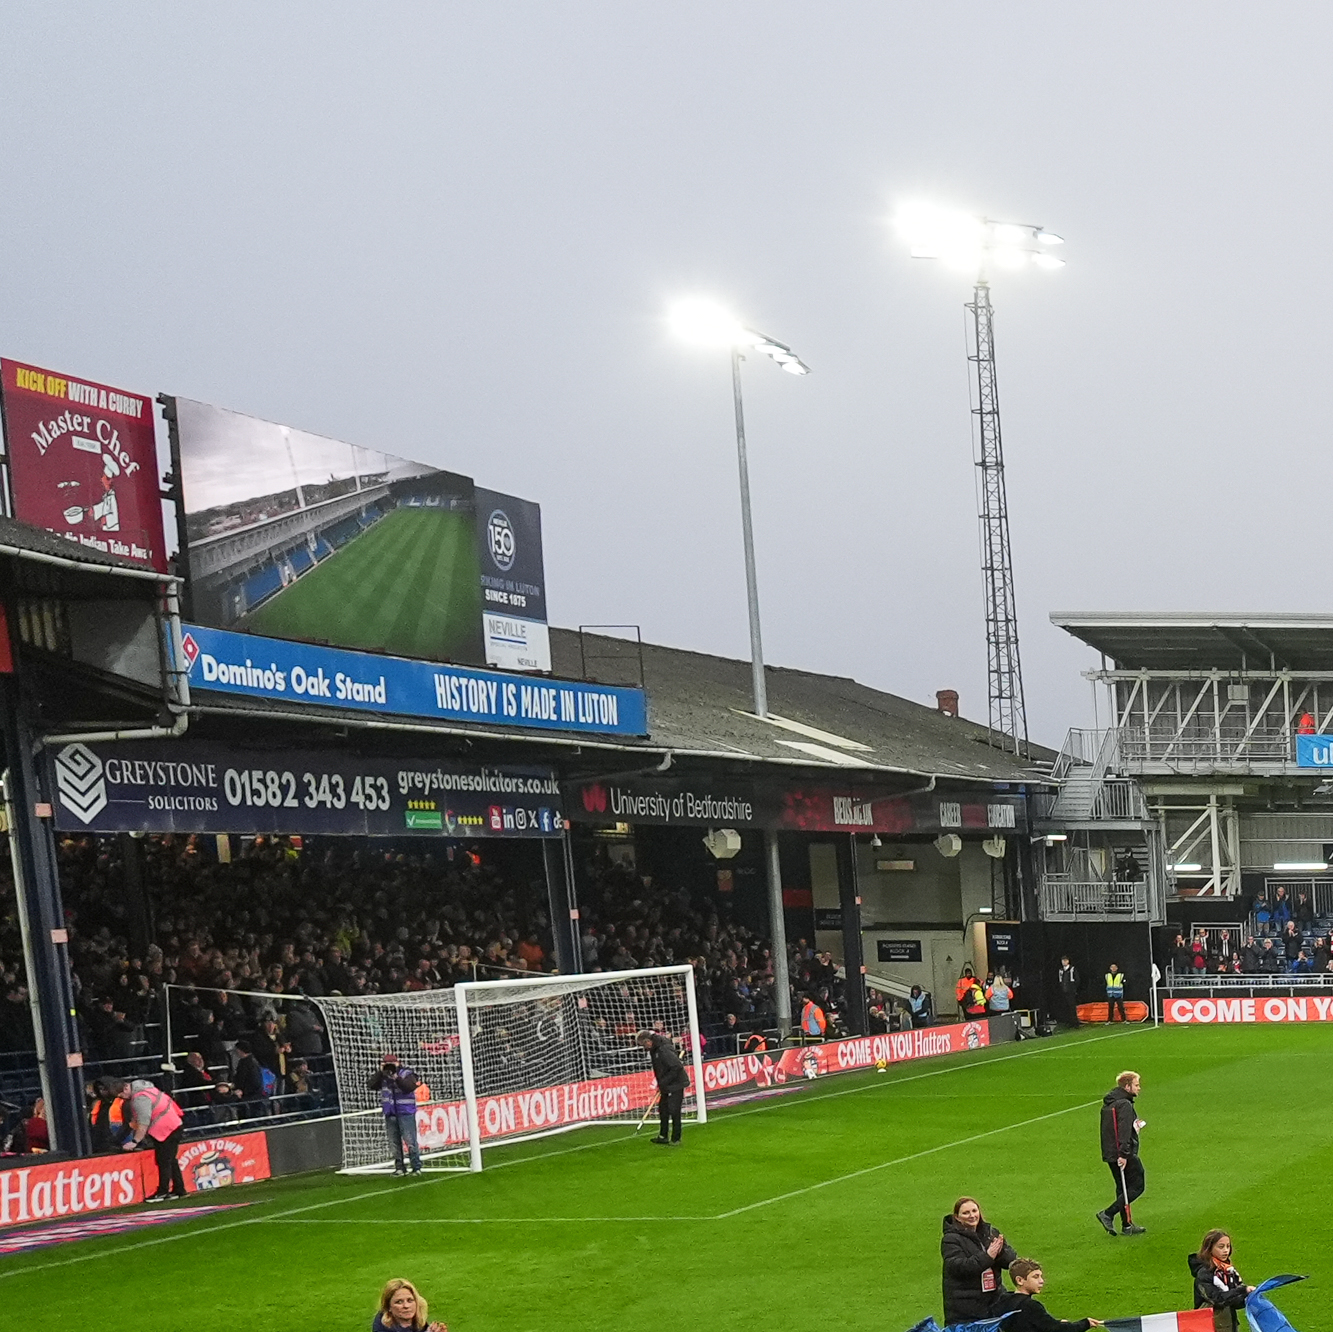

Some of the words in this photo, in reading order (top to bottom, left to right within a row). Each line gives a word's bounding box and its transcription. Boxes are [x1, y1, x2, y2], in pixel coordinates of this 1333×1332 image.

[16, 367, 45, 393] KICK
[46, 375, 67, 398] OFF
[68, 381, 98, 406] WITH
[99, 391, 107, 409] A
[108, 394, 143, 418] CURRY
[31, 409, 91, 456] Master
[96, 419, 141, 477] Chef
[80, 533, 108, 552] Indian
[108, 538, 130, 556] Take
[489, 523, 514, 556] 150
[485, 589, 509, 603] SINCE
[509, 594, 526, 607] 1875
[489, 619, 527, 638] NEVILLE
[201, 654, 286, 691] Domino's
[290, 666, 331, 698] Oak
[335, 671, 386, 704] Stand
[434, 673, 498, 715] HISTORY
[503, 682, 517, 717] IS
[521, 684, 556, 720] MADE
[560, 689, 575, 722] IN
[578, 692, 619, 725] LUTON
[105, 759, 218, 788] GREYSTONE
[224, 769, 299, 808] 01582
[303, 772, 346, 809] 343
[350, 776, 391, 811] 453
[398, 768, 559, 795] greystonesolicitors.co.uk
[148, 795, 218, 812] SOLICITORS
[610, 786, 669, 819] University
[672, 793, 685, 815] of
[686, 794, 753, 821] Bedfordshire
[1170, 998, 1256, 1022] COME
[1263, 999, 1310, 1021] ON
[837, 1040, 872, 1070] COME
[873, 1035, 891, 1061] ON
[890, 1031, 913, 1060] YOU
[914, 1028, 951, 1057] Hatters
[705, 1056, 747, 1087] COME
[416, 1103, 480, 1149] COM
[485, 1096, 518, 1133] ON
[518, 1088, 558, 1127] YOU
[564, 1080, 629, 1123] Hatters
[209, 1139, 244, 1156] TOWN
[0, 1168, 135, 1225] Hatters
